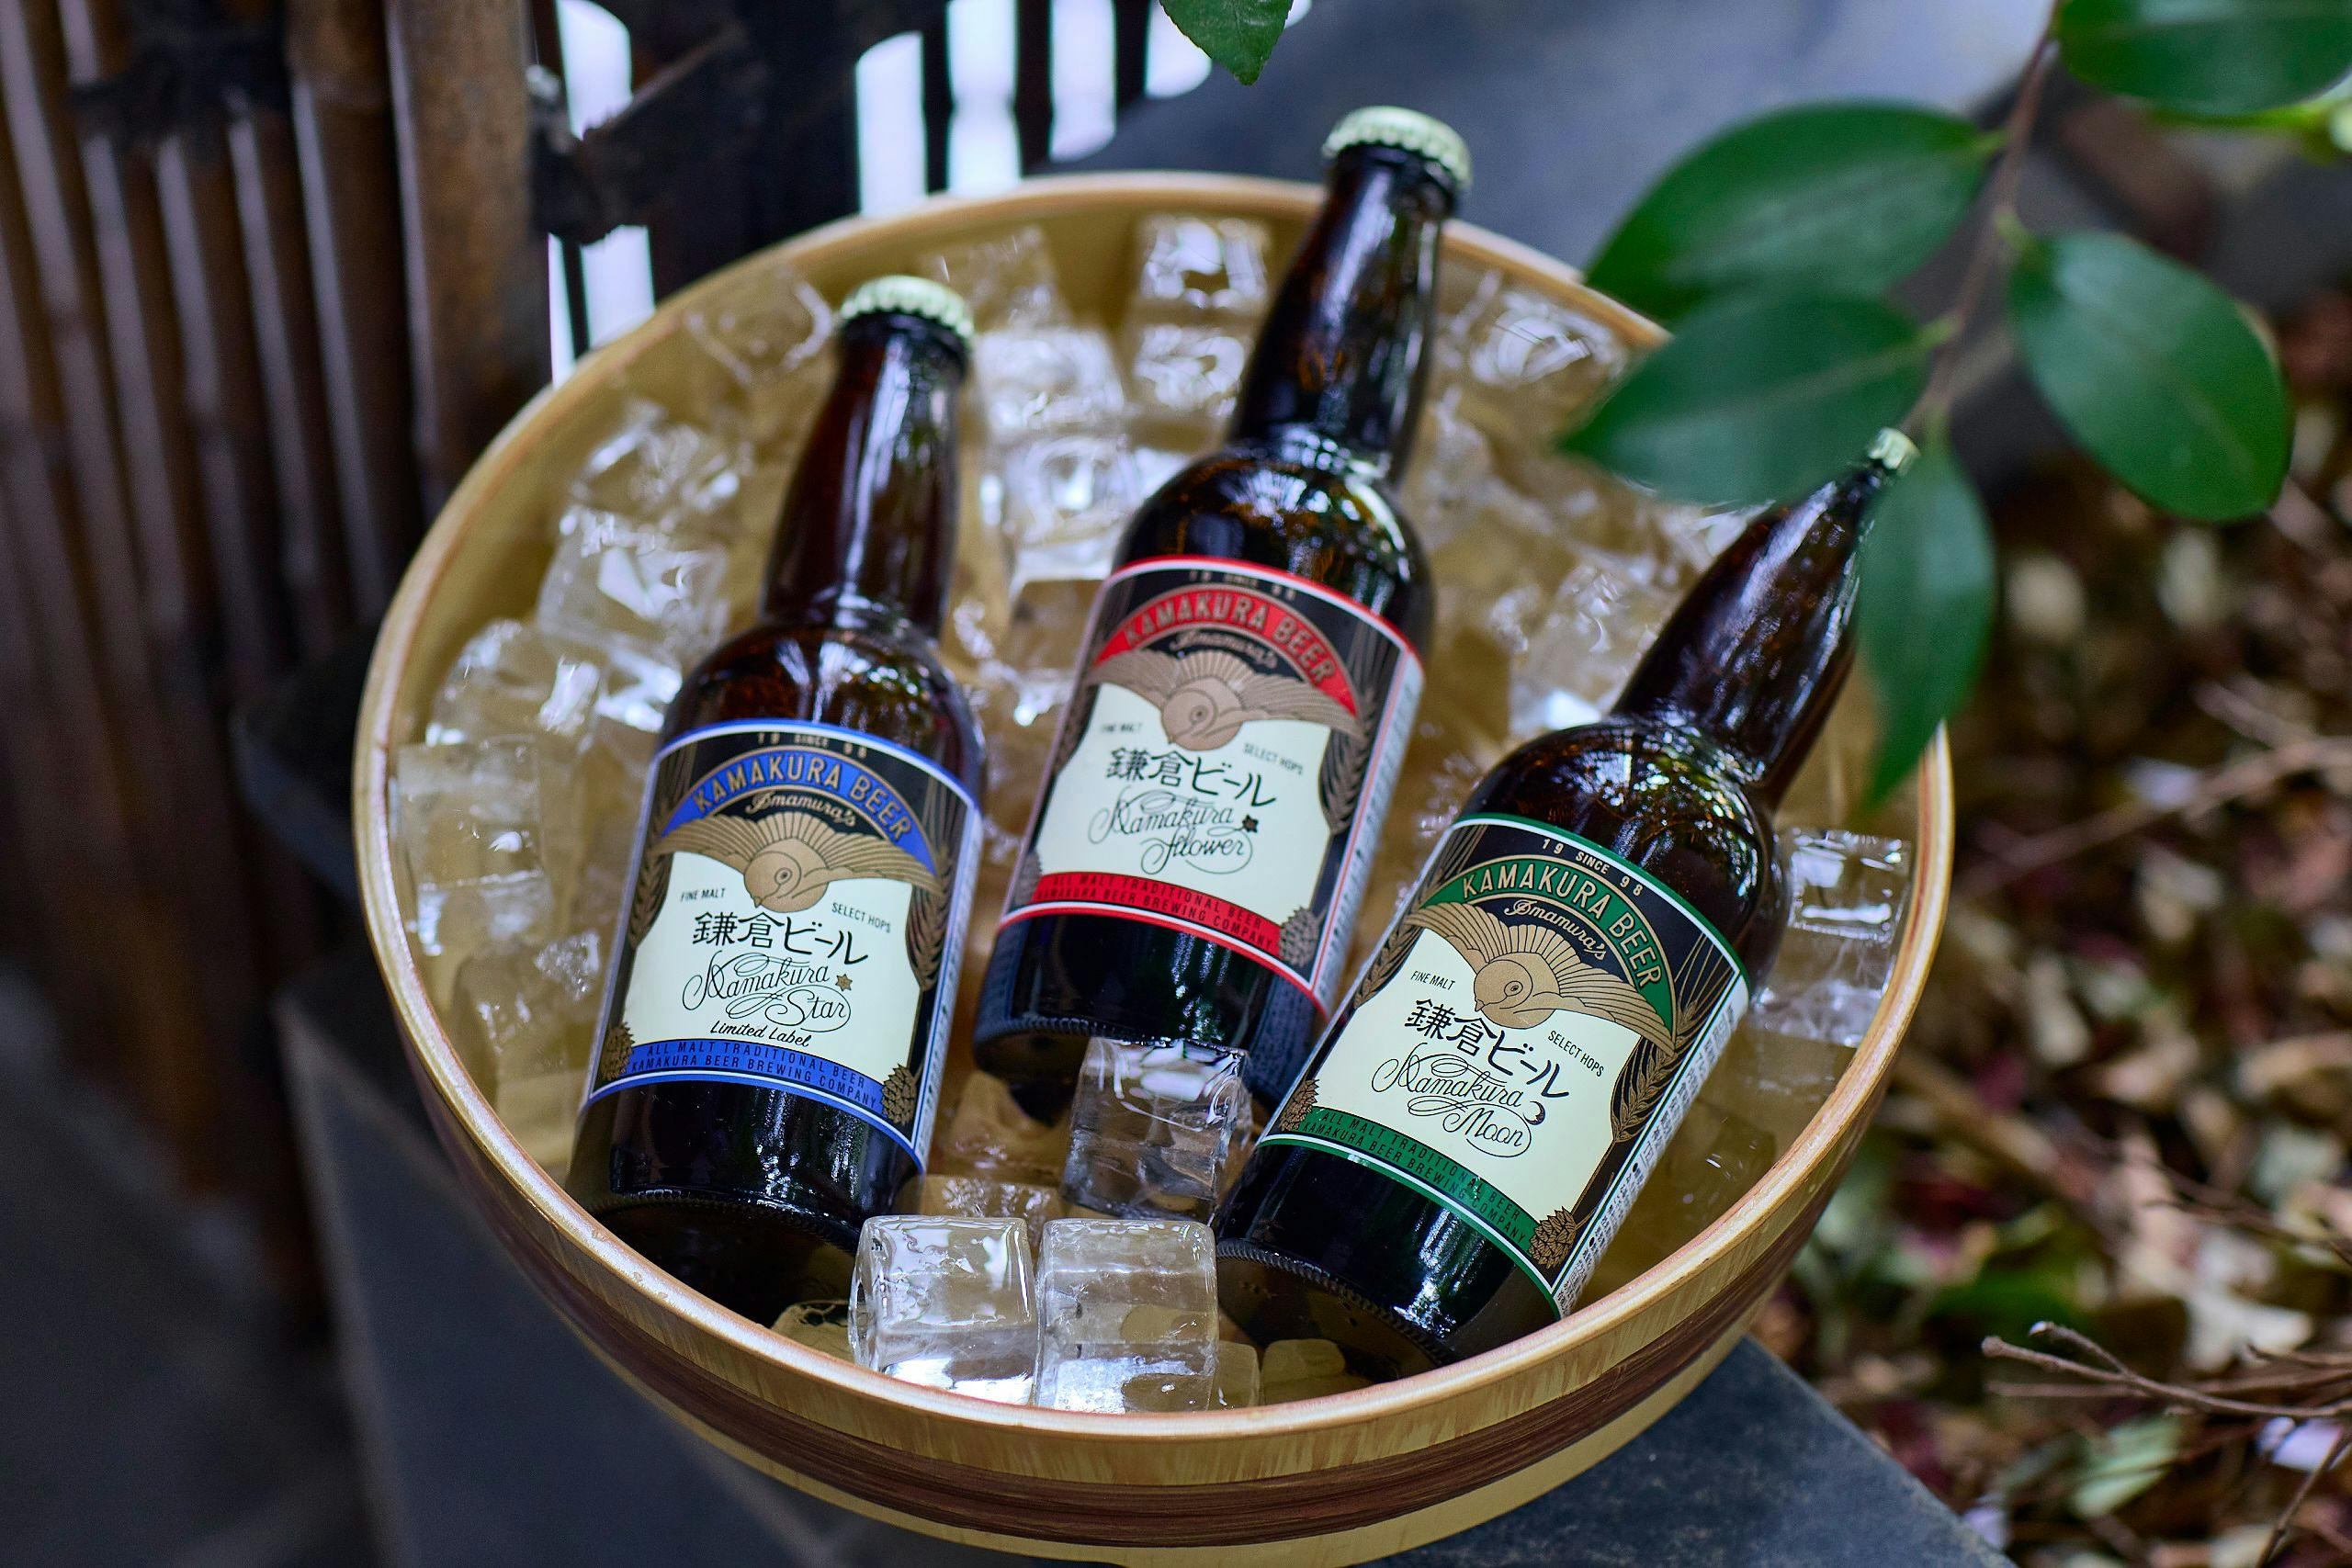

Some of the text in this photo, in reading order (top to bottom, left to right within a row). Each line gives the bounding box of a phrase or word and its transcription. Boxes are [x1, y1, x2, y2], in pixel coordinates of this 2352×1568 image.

[1123, 593, 1336, 685] KAMAKURA BEER
[693, 753, 912, 841] KAMAKURA BEER
[1105, 746, 1277, 807] 鎌倉ビール
[1088, 784, 1235, 845] Kamakura
[1575, 850, 1611, 874] SINCE
[701, 887, 727, 899] MALT
[831, 902, 892, 934] SELECT HOPS
[1102, 888, 1136, 904] BEER
[1144, 896, 1207, 921] BREWING
[1212, 916, 1273, 949] COMPANY
[1122, 874, 1220, 912] TRADITIONAL
[1227, 906, 1262, 930] BEER
[692, 911, 869, 965] 鎌倉ビール
[1462, 862, 1663, 988] KAMAKURA BEER
[682, 950, 831, 1011] Kamakura
[1410, 970, 1456, 991] FINE MALT
[710, 1020, 812, 1048] Limited Label
[764, 986, 852, 1032] Star
[647, 1042, 866, 1089] ALL MALT TRADITIONAL BEER
[1371, 1042, 1525, 1108] Kamakura
[1404, 998, 1570, 1099] 鎌倉ビール
[1547, 1030, 1606, 1078] SELECT HOPS
[631, 1054, 878, 1109] KAMAKURA BEER BREWING COMPANY
[1442, 1106, 1532, 1157] Moon
[1302, 1121, 1527, 1246] KAMAKURA BEER BREWING COMPANY
[1321, 1108, 1521, 1221] ALL MALT TRADITIONAL BEER
